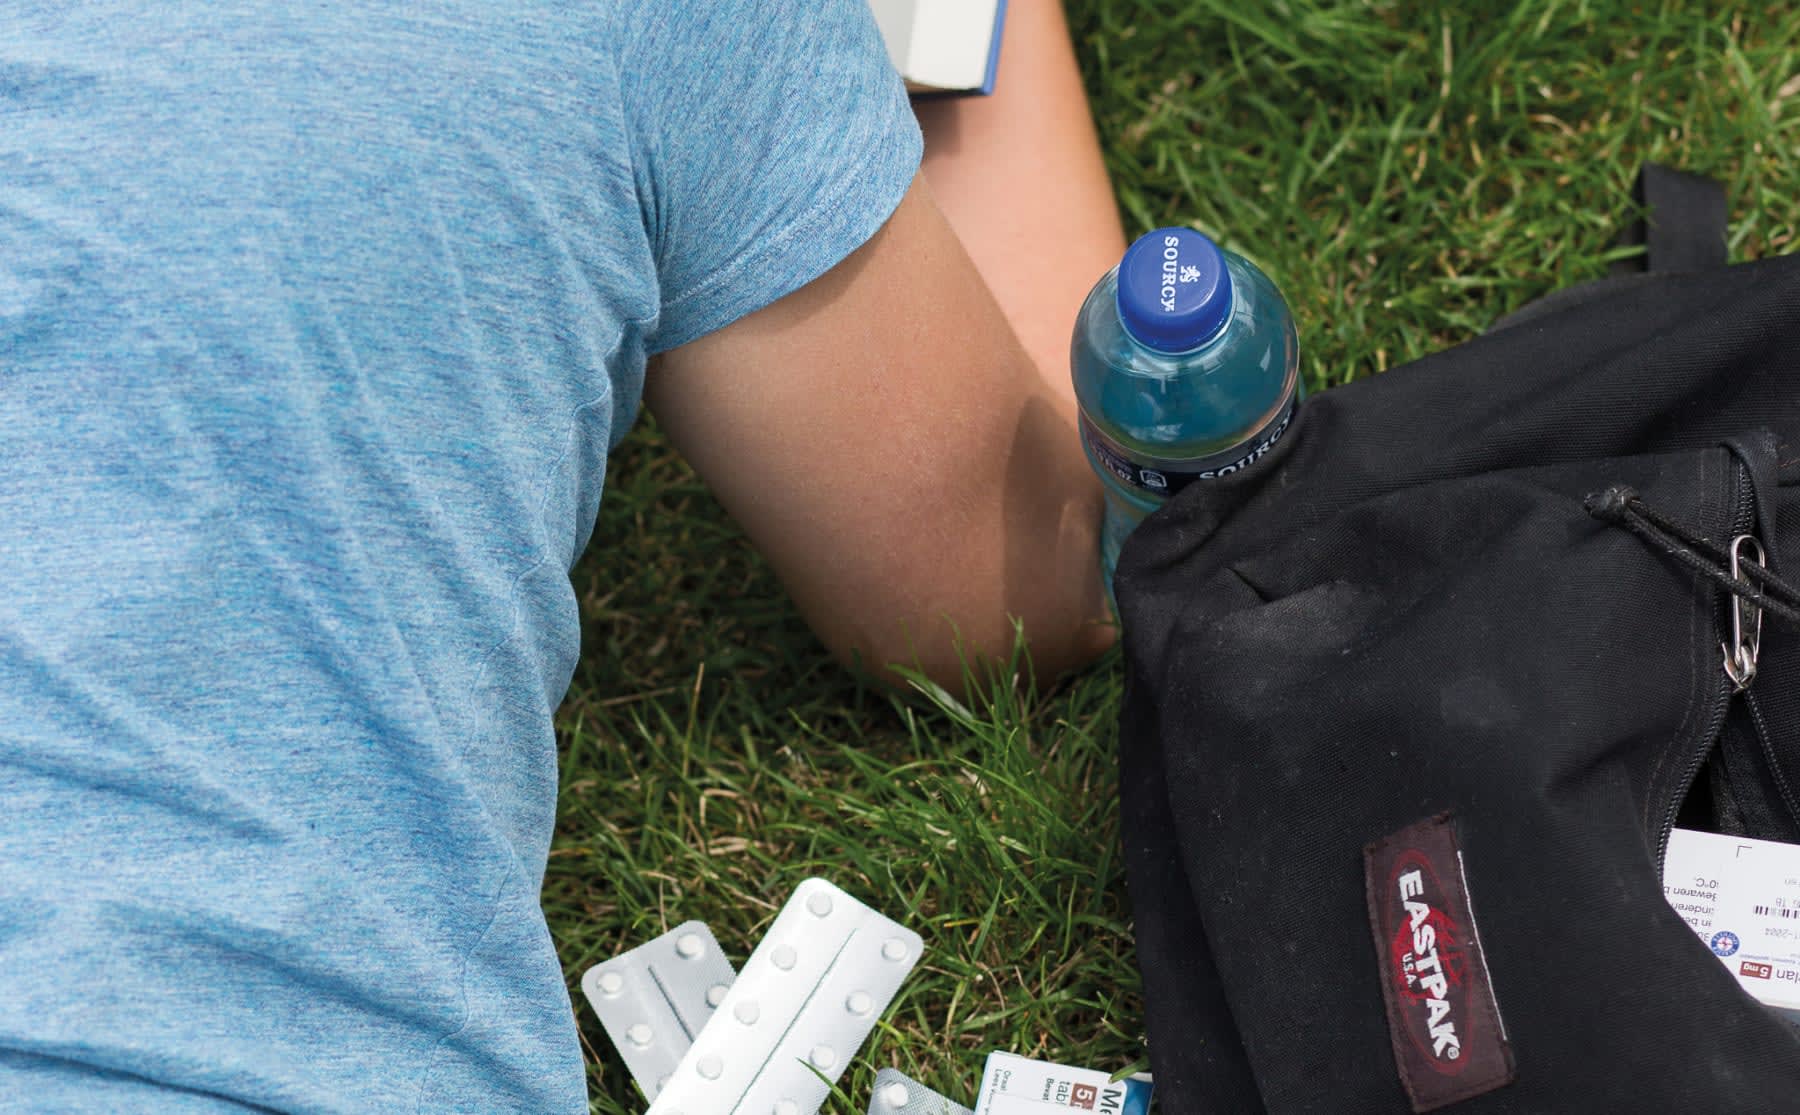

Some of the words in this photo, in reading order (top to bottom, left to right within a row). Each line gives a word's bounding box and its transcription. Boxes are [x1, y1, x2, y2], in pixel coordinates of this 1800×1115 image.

[1161, 236, 1179, 312] SOURCY
[1402, 953, 1417, 988] U.S.A.
[1743, 962, 1760, 972] mg
[1759, 966, 1770, 978] 5
[1776, 967, 1800, 984] lan
